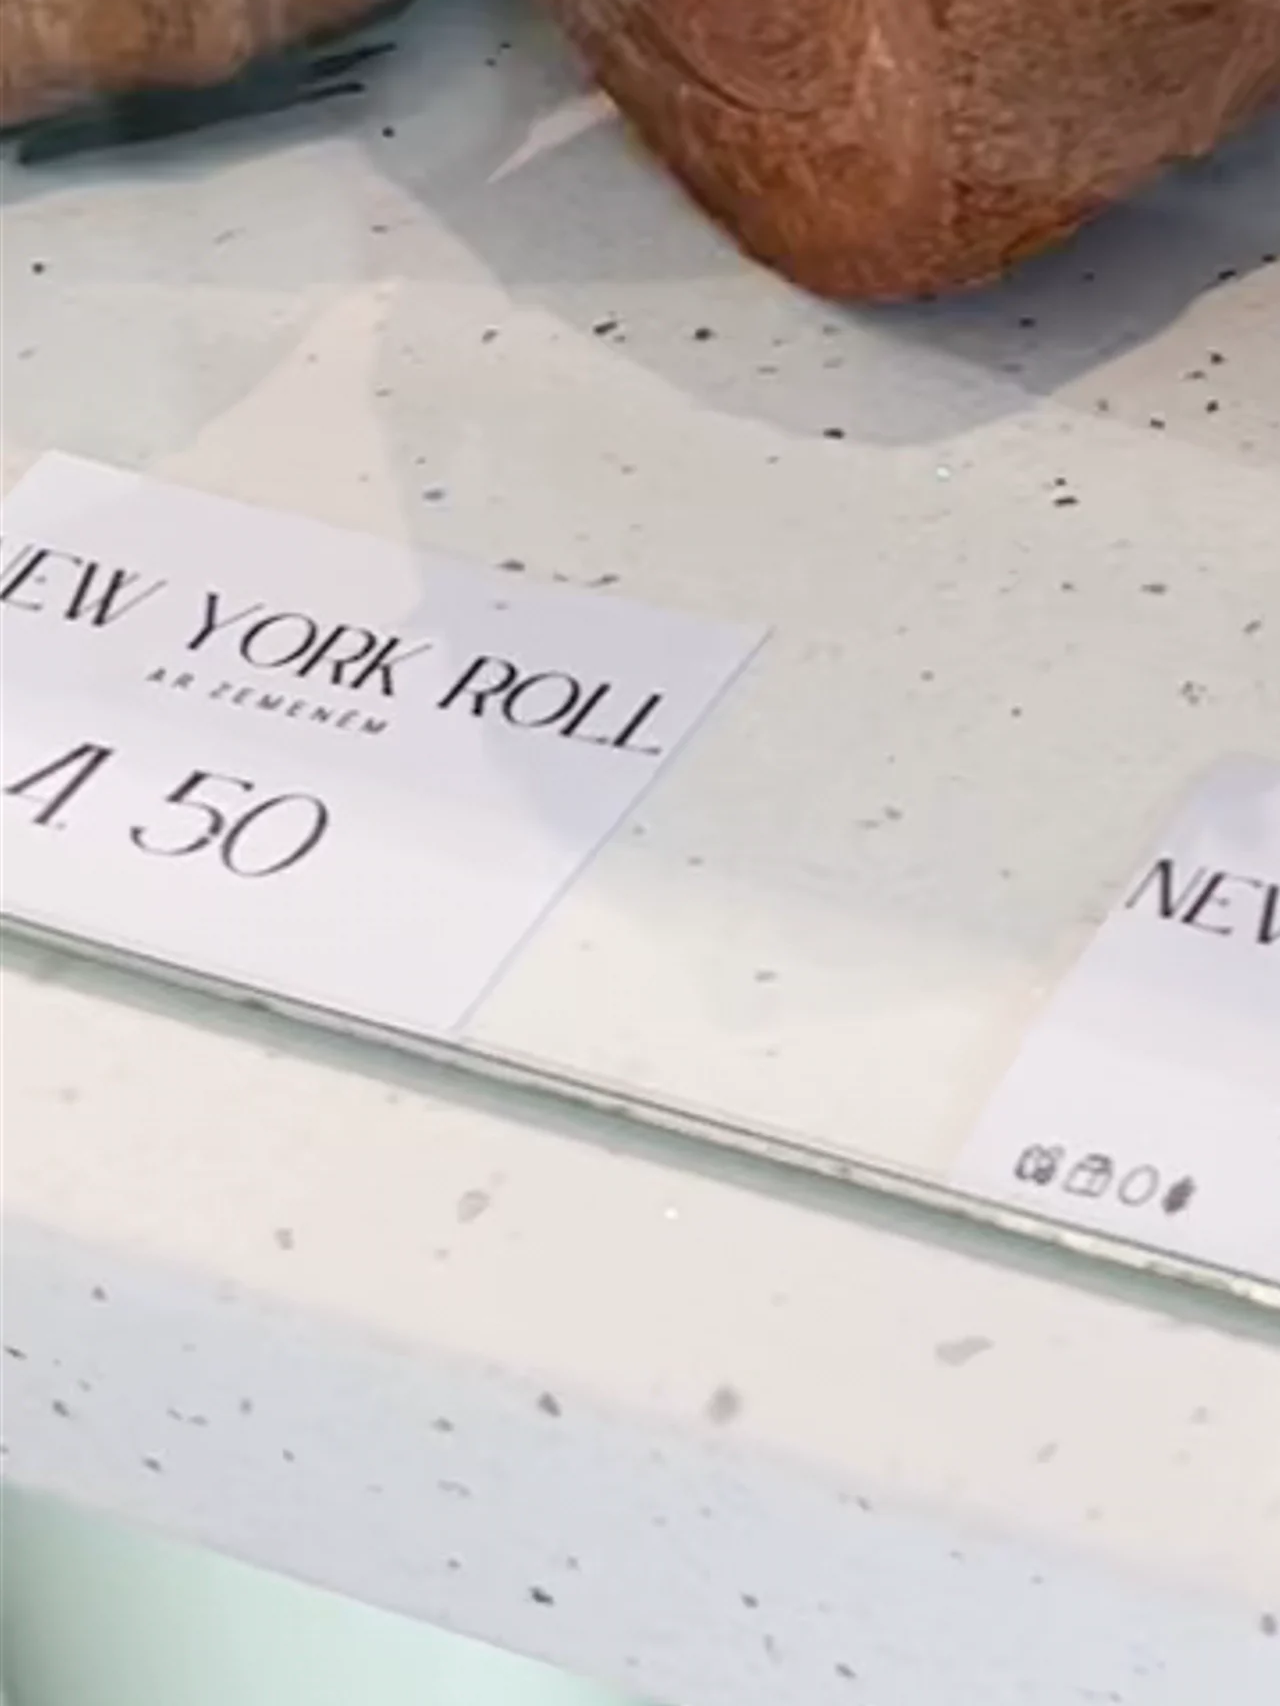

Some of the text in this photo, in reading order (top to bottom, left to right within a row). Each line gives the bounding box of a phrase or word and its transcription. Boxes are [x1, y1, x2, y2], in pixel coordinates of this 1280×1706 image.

[145, 666, 195, 690] AR
[186, 591, 432, 698] YORK
[436, 654, 663, 757] ROLL
